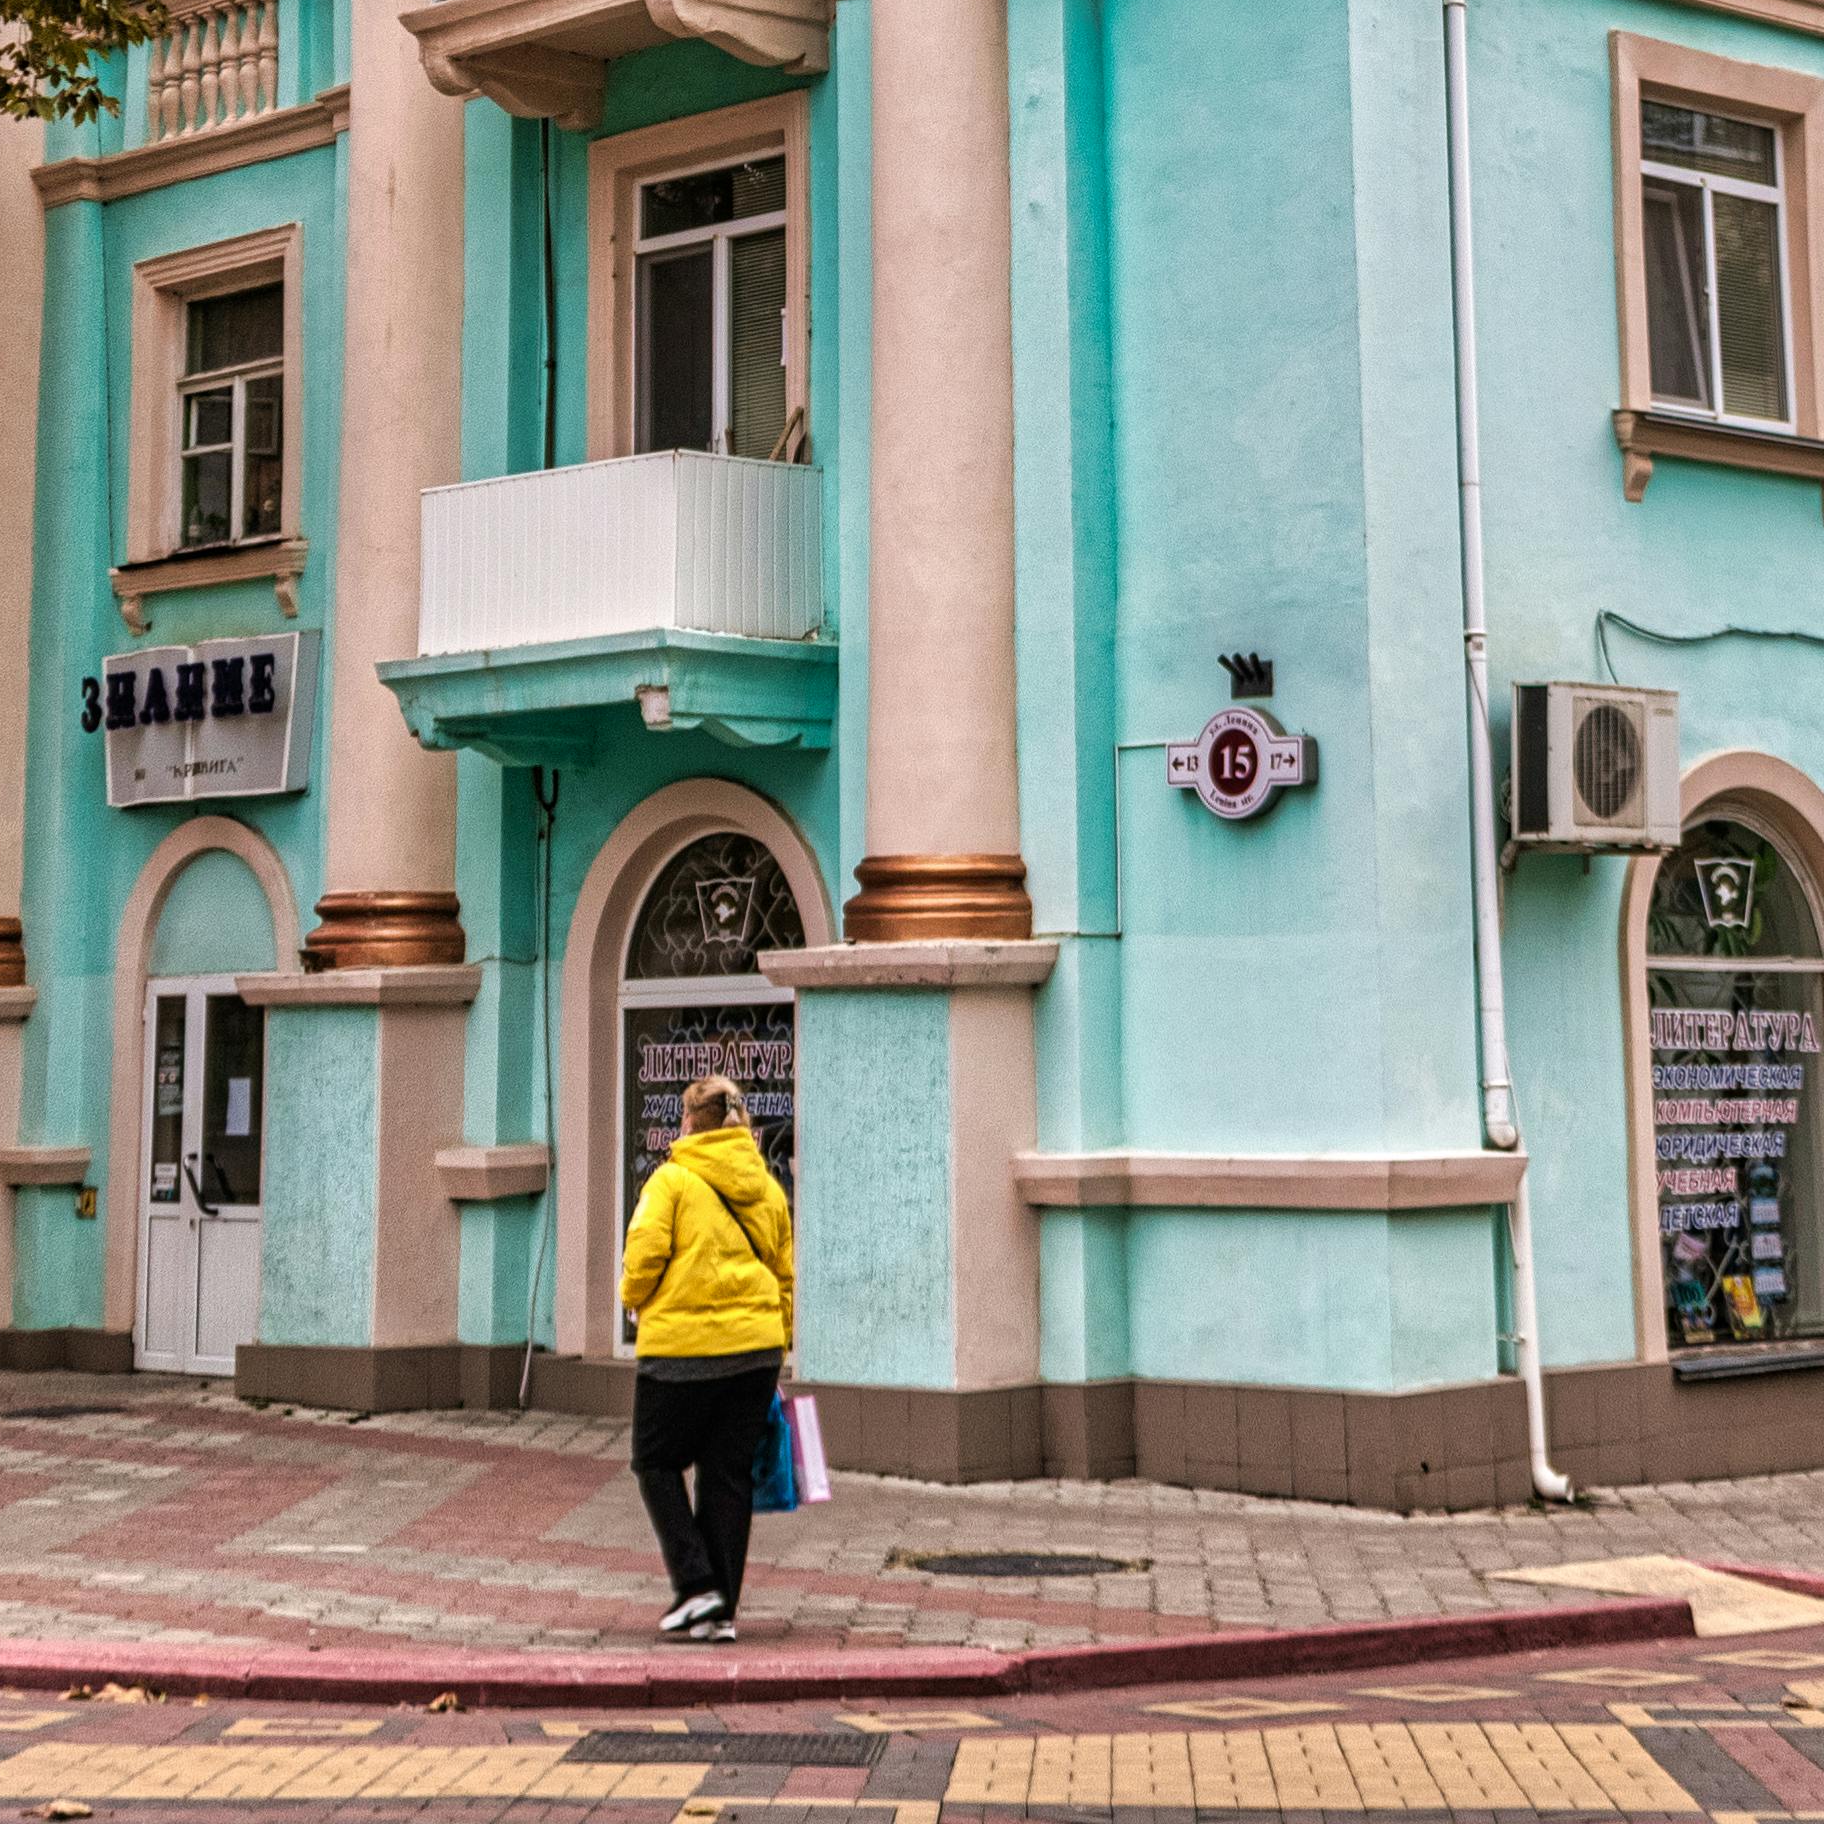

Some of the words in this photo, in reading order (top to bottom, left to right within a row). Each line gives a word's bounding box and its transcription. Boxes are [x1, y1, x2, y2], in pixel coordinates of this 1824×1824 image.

[81, 653, 275, 734] ЗНАНИЕ
[1187, 755, 1199, 772] 13
[1220, 744, 1251, 779] 15
[1270, 753, 1282, 770] 17
[1651, 1008, 1821, 1053] ЛИТЕРАТУРА
[639, 1040, 794, 1082] ЛИТЕРАТУР
[1652, 1063, 1804, 1090] ЭКОНОМИЧЕСКАЯ
[1655, 1098, 1798, 1124] КОМПЬЮТЕРНАЯ
[1655, 1131, 1786, 1164] ЮРИДИЧЕСКАЯ
[1656, 1166, 1738, 1195] УЧЕБНАЯ
[1659, 1198, 1740, 1234] ДЕТСКАЯ
